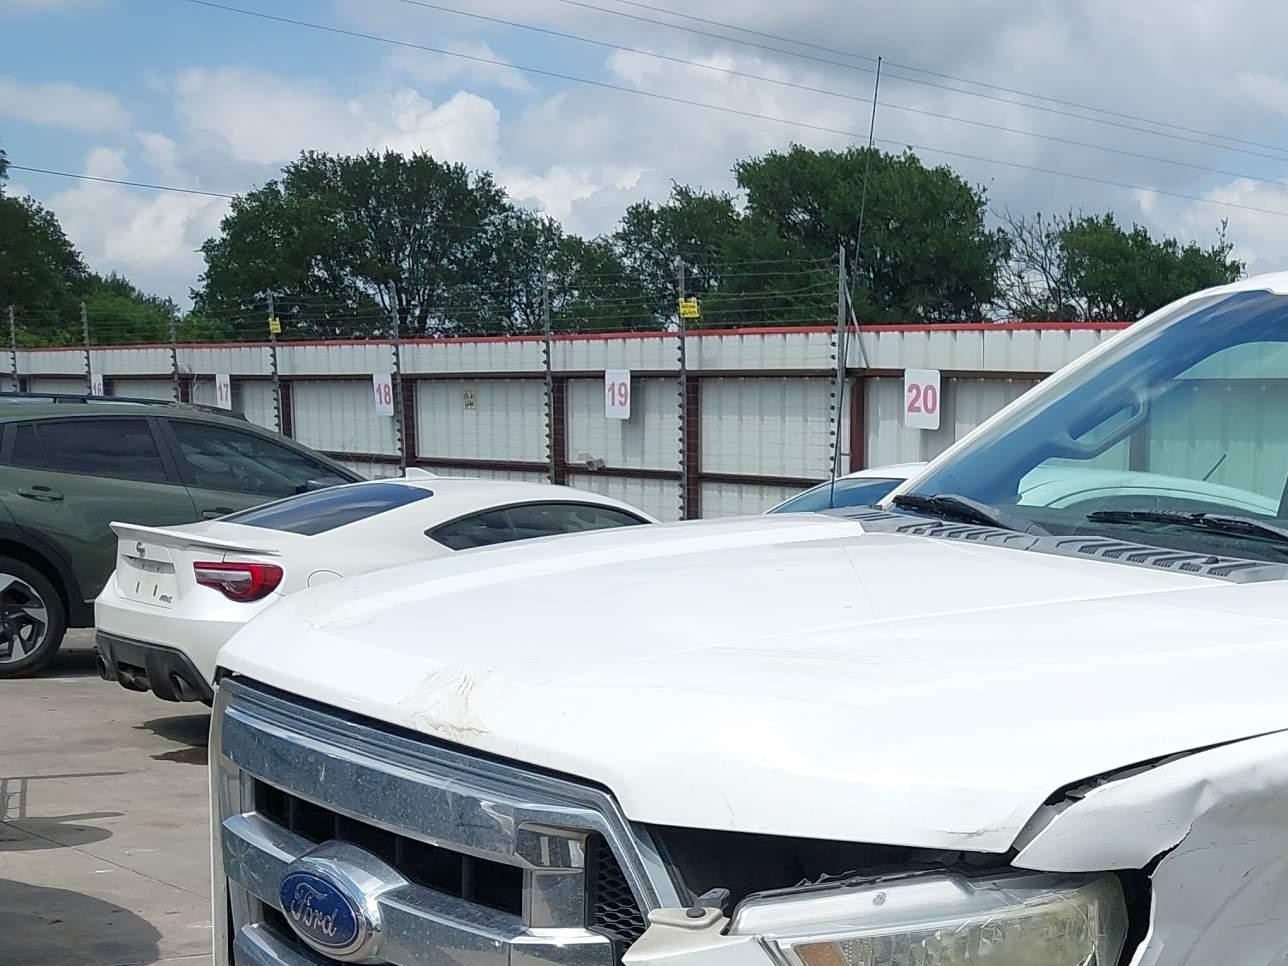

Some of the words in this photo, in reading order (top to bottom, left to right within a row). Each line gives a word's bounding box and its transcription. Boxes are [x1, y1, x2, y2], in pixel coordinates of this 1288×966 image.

[218, 383, 230, 401] 17
[376, 383, 392, 405] 18
[608, 381, 629, 407] 19
[907, 383, 938, 415] 20
[290, 881, 338, 937] Ford
